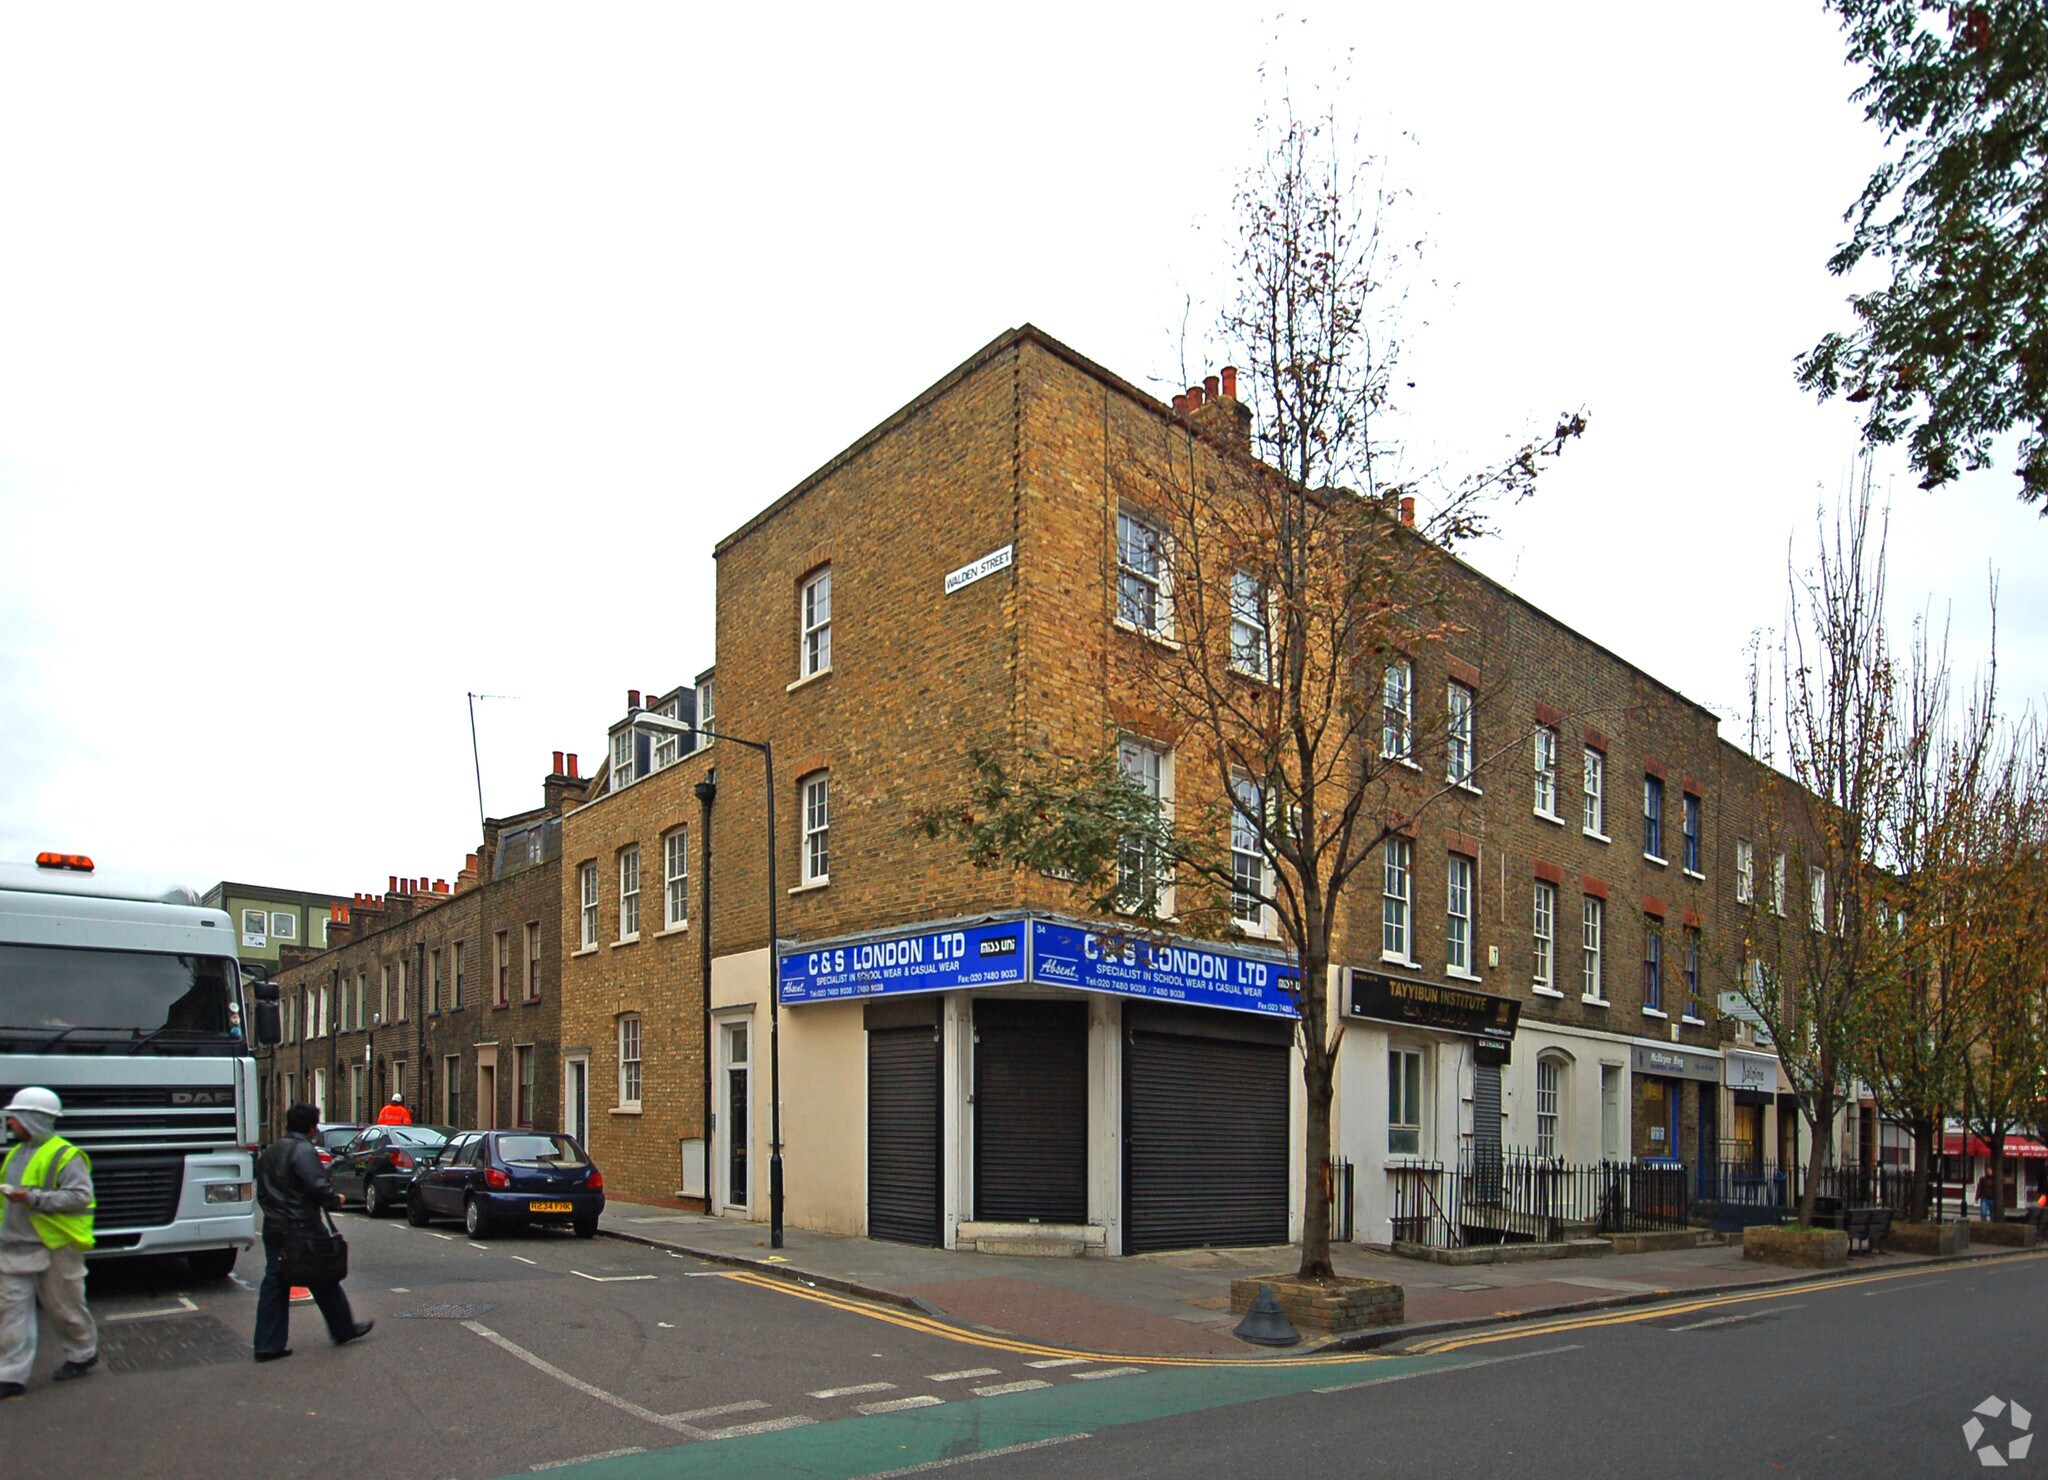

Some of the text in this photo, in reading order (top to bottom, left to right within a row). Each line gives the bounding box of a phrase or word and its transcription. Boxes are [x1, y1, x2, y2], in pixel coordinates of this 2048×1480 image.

[947, 551, 1009, 589] WALDEN STREET
[1036, 925, 1046, 934] 34
[808, 932, 966, 976] C & S LONDON LTD
[1084, 934, 1098, 960] C
[1123, 942, 1136, 966] S
[1148, 945, 1228, 980] LONDON
[1238, 961, 1267, 987] LTD
[816, 960, 960, 986] SPECIALIST IN SCHOOL WEAR & CASUAL WEAR
[984, 971, 1000, 980] 7480
[1000, 969, 1018, 979] 9033
[1096, 964, 1262, 998] SPECIALIST IN SCHOOL WEAR & CASUAL WEAR
[827, 988, 839, 996] 7480
[1112, 981, 1128, 991] 7480
[1152, 986, 1168, 996] 7480
[1389, 980, 1487, 1011] TAYYIBUN INSTITUTE
[172, 1092, 232, 1104] DAF
